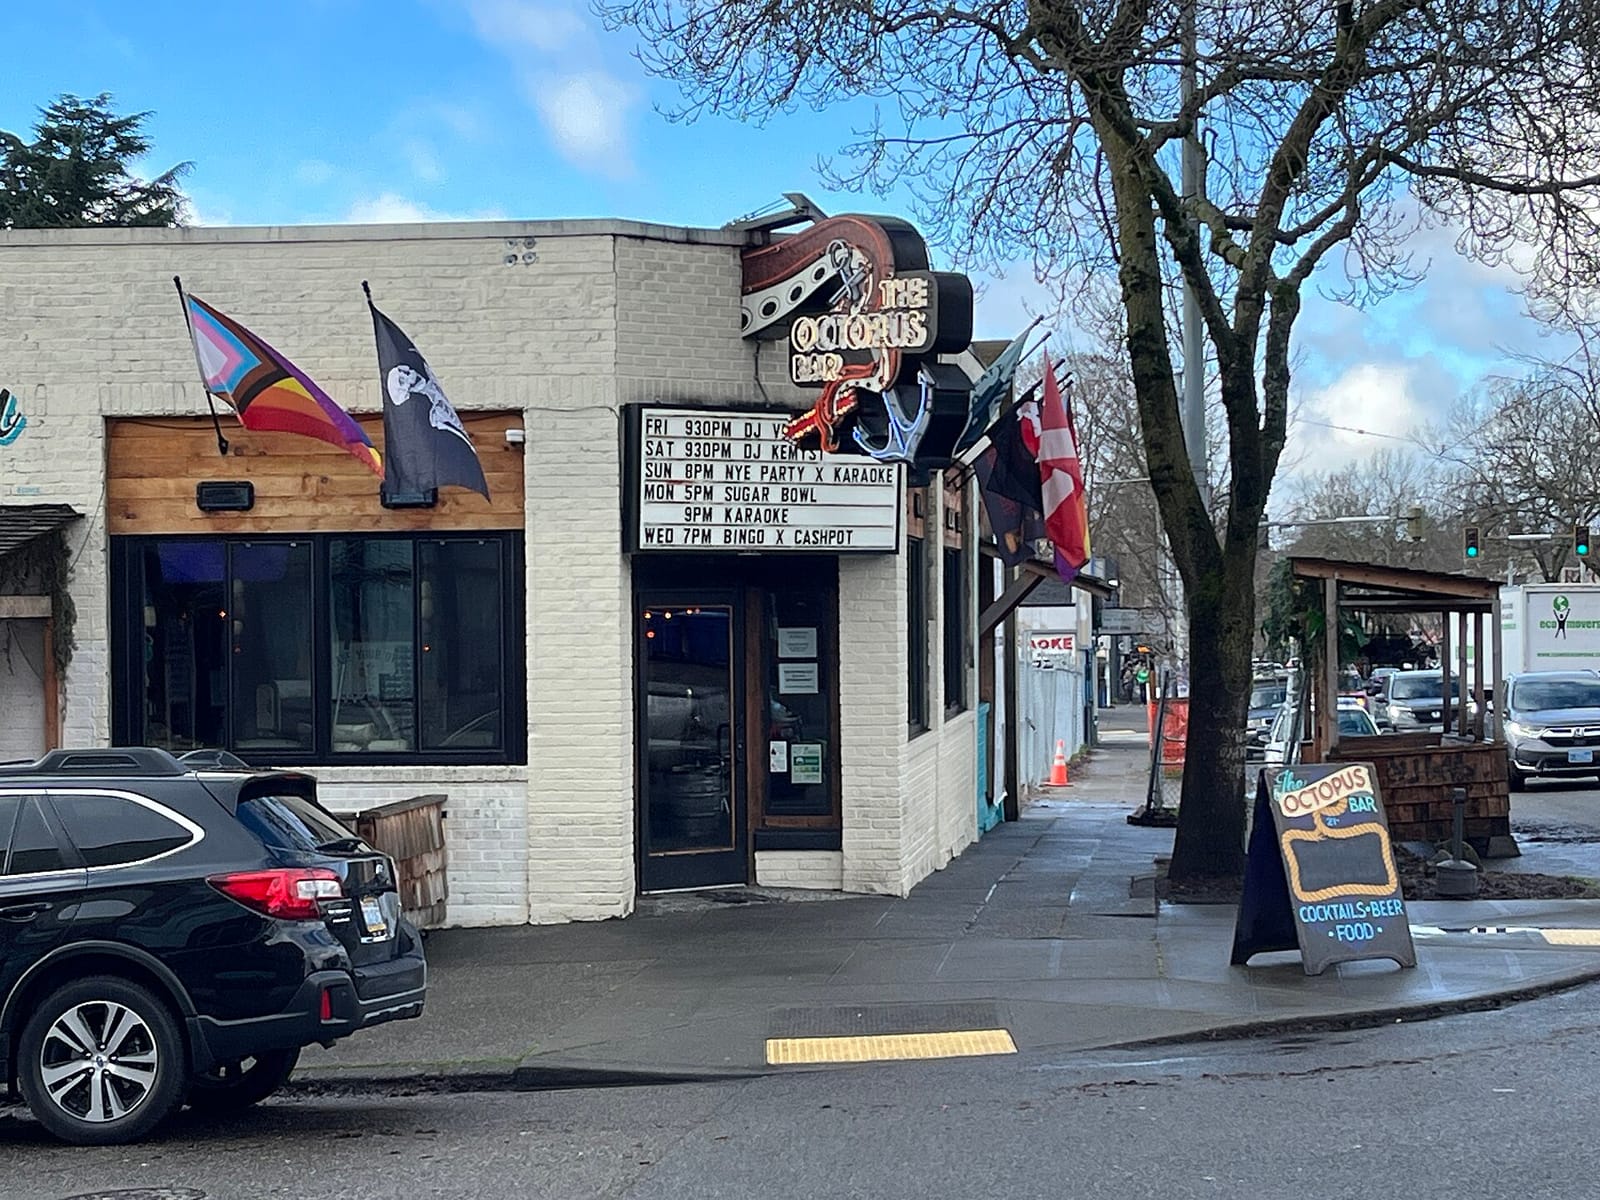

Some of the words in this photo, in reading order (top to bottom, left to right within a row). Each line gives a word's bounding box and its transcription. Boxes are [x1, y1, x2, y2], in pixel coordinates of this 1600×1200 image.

[879, 277, 929, 309] THE
[791, 310, 928, 352] OCTOPUS
[792, 352, 844, 382] BAR
[645, 419, 668, 436] FRI
[685, 420, 731, 437] 930PM
[744, 421, 762, 437] DJ
[645, 441, 674, 456] SAT
[685, 442, 731, 458] 930PM
[744, 443, 762, 459] DJ
[645, 462, 672, 479] SUN
[685, 463, 713, 479] 8PM
[725, 465, 750, 480] NYE
[760, 465, 802, 482] PARTY
[815, 467, 824, 481] X
[834, 467, 893, 483] KARAOKE
[644, 484, 674, 500] MON
[684, 485, 713, 501] 5PM
[724, 486, 770, 502] SUGAR
[781, 487, 817, 502] BOWL
[684, 507, 712, 522] 9PM
[724, 508, 788, 523] KARAOKE
[644, 527, 673, 544] WED
[683, 528, 711, 544] 7PM
[724, 529, 764, 544] BINGO
[776, 529, 784, 544] X
[794, 530, 853, 545] CASHPOT
[1274, 769, 1306, 794] The
[1283, 768, 1366, 813] OCTOPUS
[1348, 796, 1378, 813] BAR
[1335, 923, 1374, 942] FOOD
